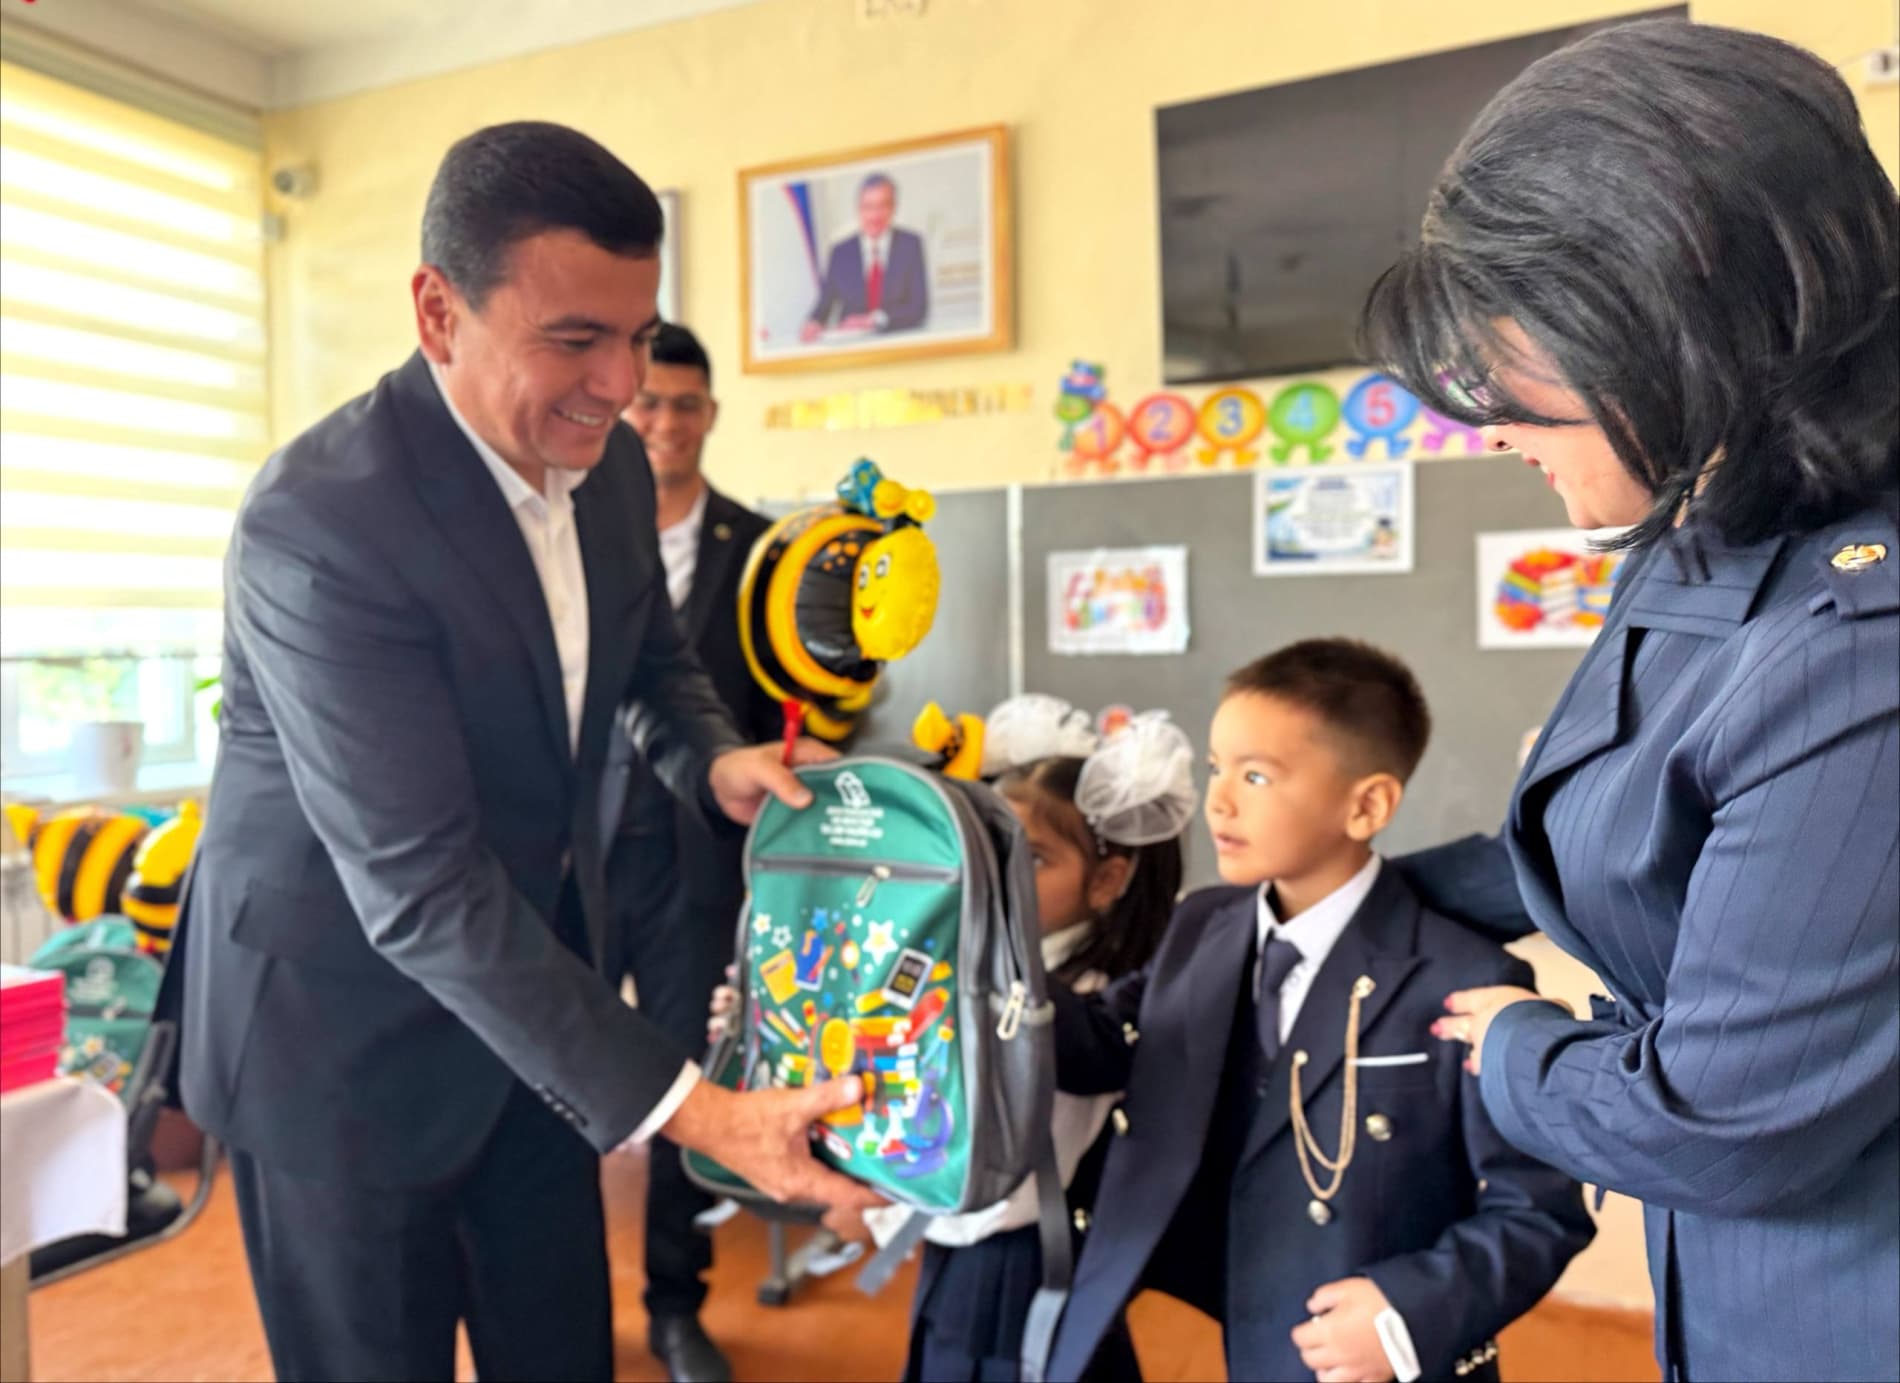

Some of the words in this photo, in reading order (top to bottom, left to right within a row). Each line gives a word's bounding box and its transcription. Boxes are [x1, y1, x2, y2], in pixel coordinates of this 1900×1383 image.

[1147, 402, 1174, 441] 2
[1218, 397, 1243, 437] 3
[1286, 390, 1314, 433] 4
[1366, 382, 1396, 428] 5
